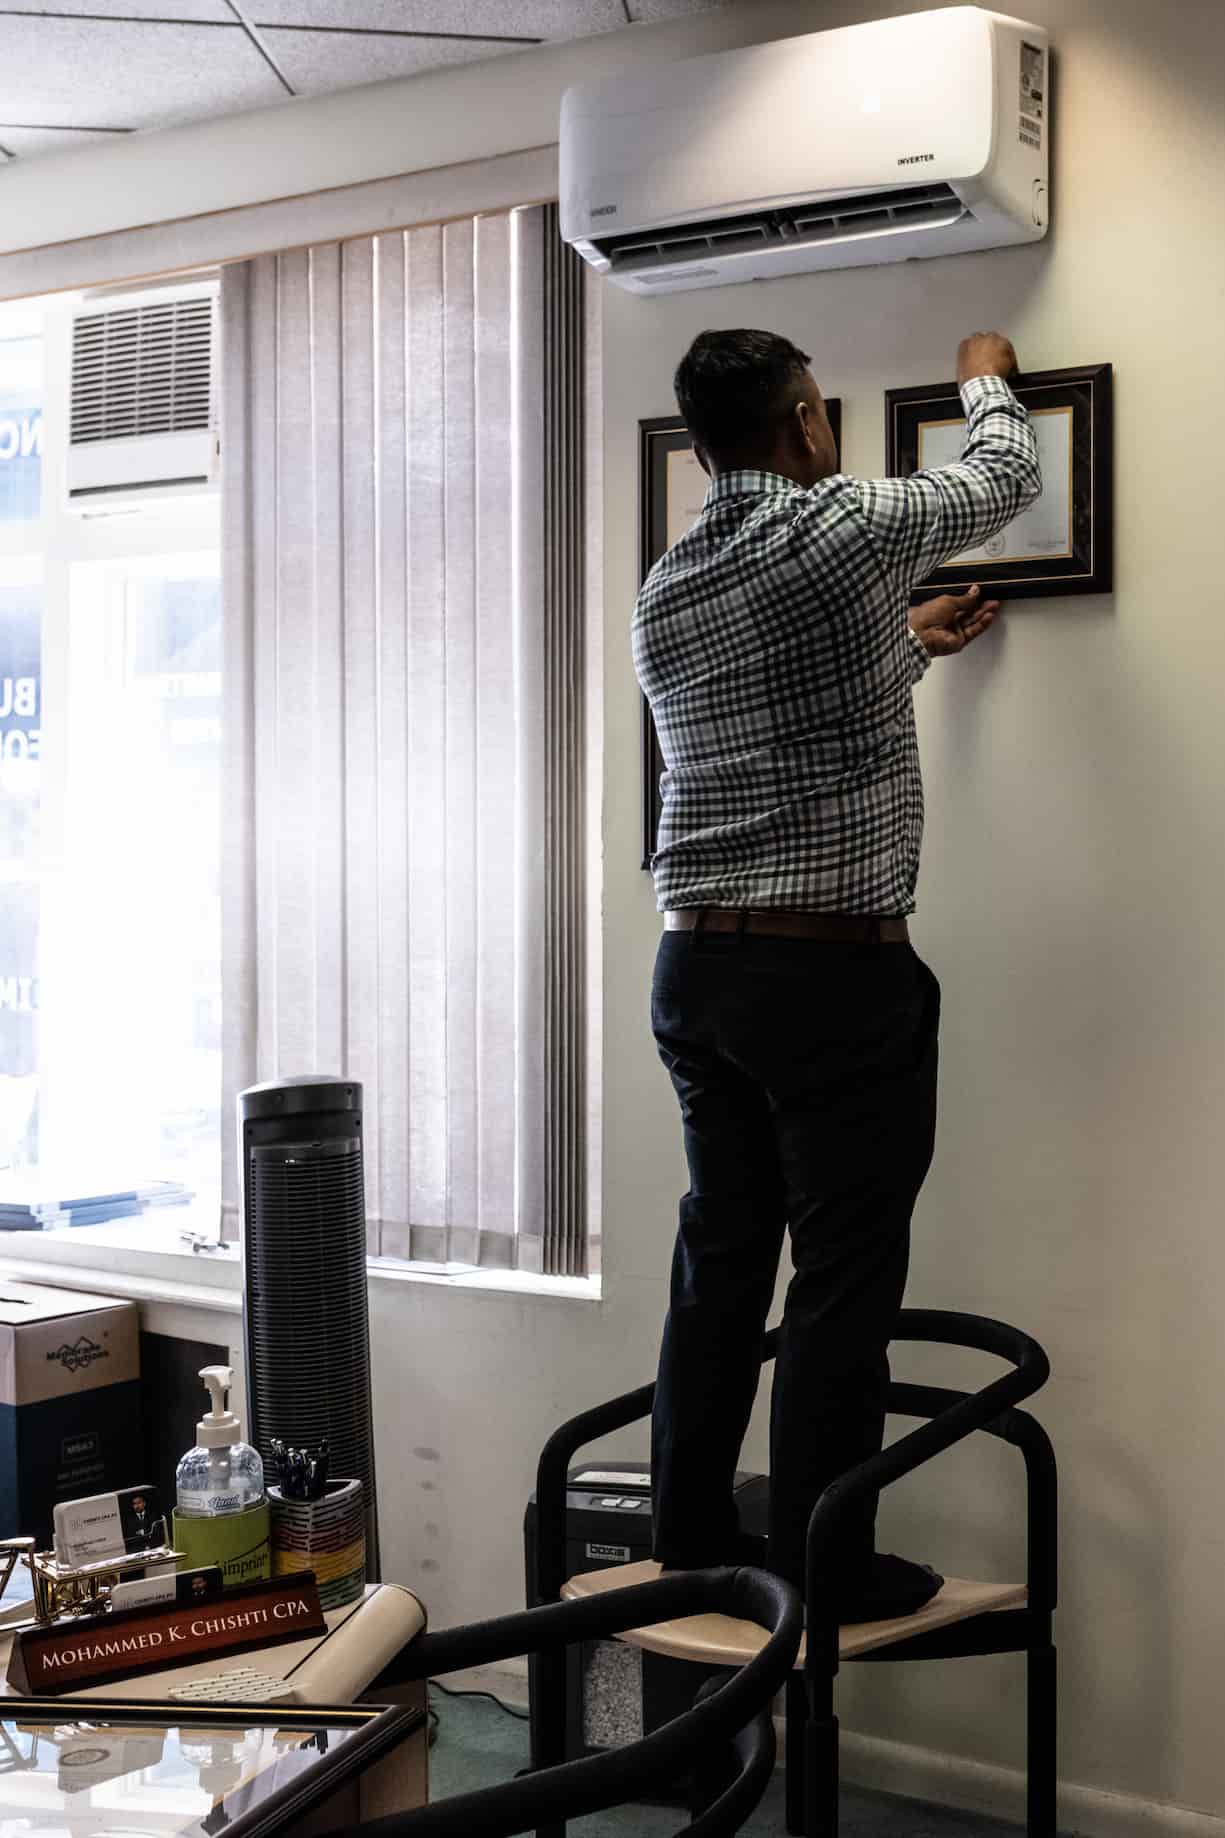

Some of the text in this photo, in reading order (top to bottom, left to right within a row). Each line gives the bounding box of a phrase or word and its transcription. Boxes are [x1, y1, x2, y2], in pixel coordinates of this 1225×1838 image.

[897, 153, 934, 166] INVERTER
[42, 1600, 310, 1670] MOHAMMED K. CHISHTI CPA
